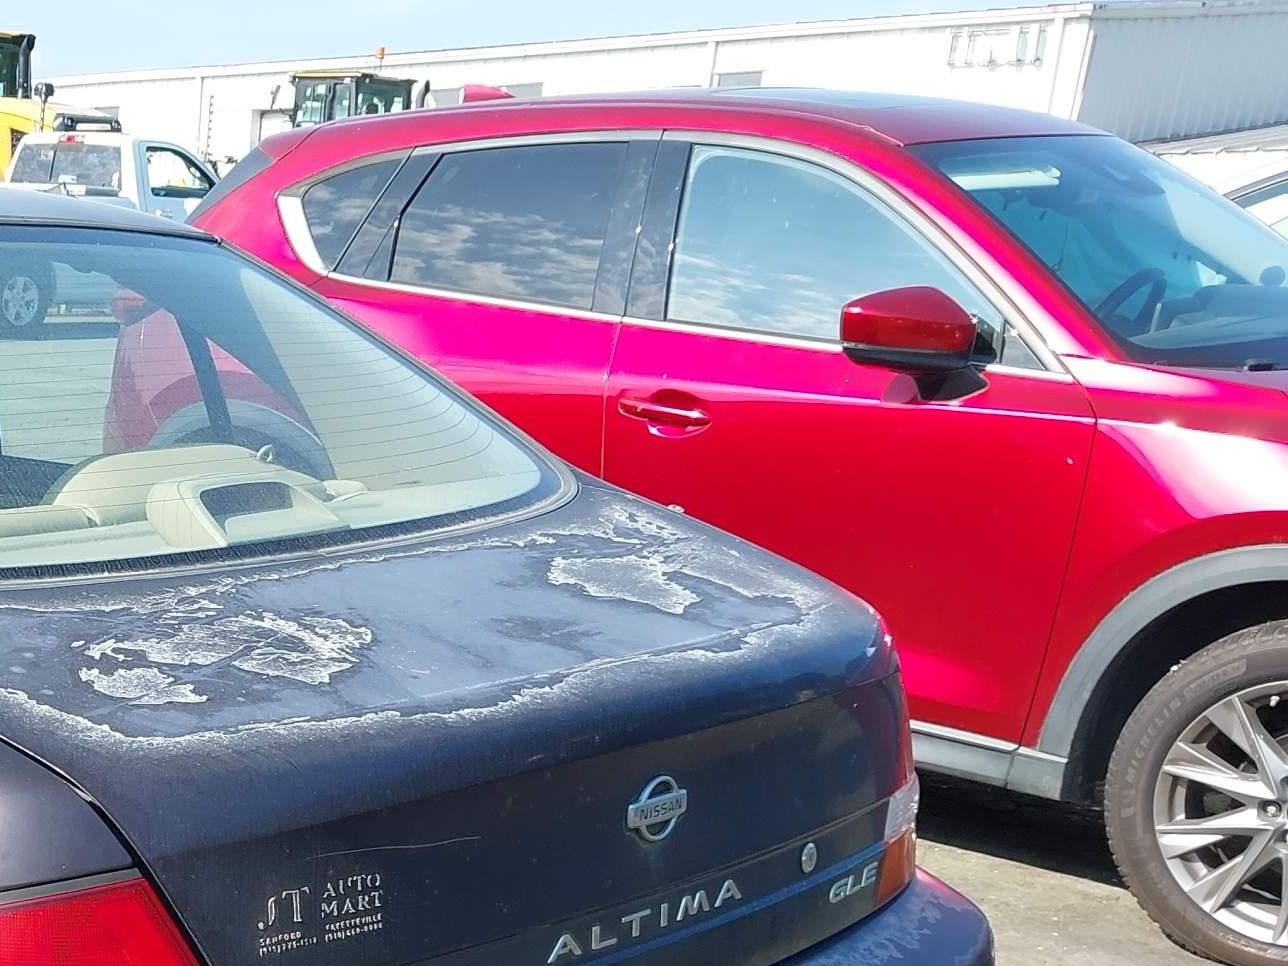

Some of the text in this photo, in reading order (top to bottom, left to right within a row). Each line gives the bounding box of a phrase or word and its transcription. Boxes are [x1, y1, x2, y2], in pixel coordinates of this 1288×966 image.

[639, 796, 683, 821] NISSAN
[323, 873, 381, 898] AUTO
[829, 861, 879, 904] GLE
[321, 889, 384, 919] MART
[325, 912, 382, 931] FAYETTEVILLE
[547, 878, 743, 964] ALTIMA
[259, 931, 302, 946] SANFORD
